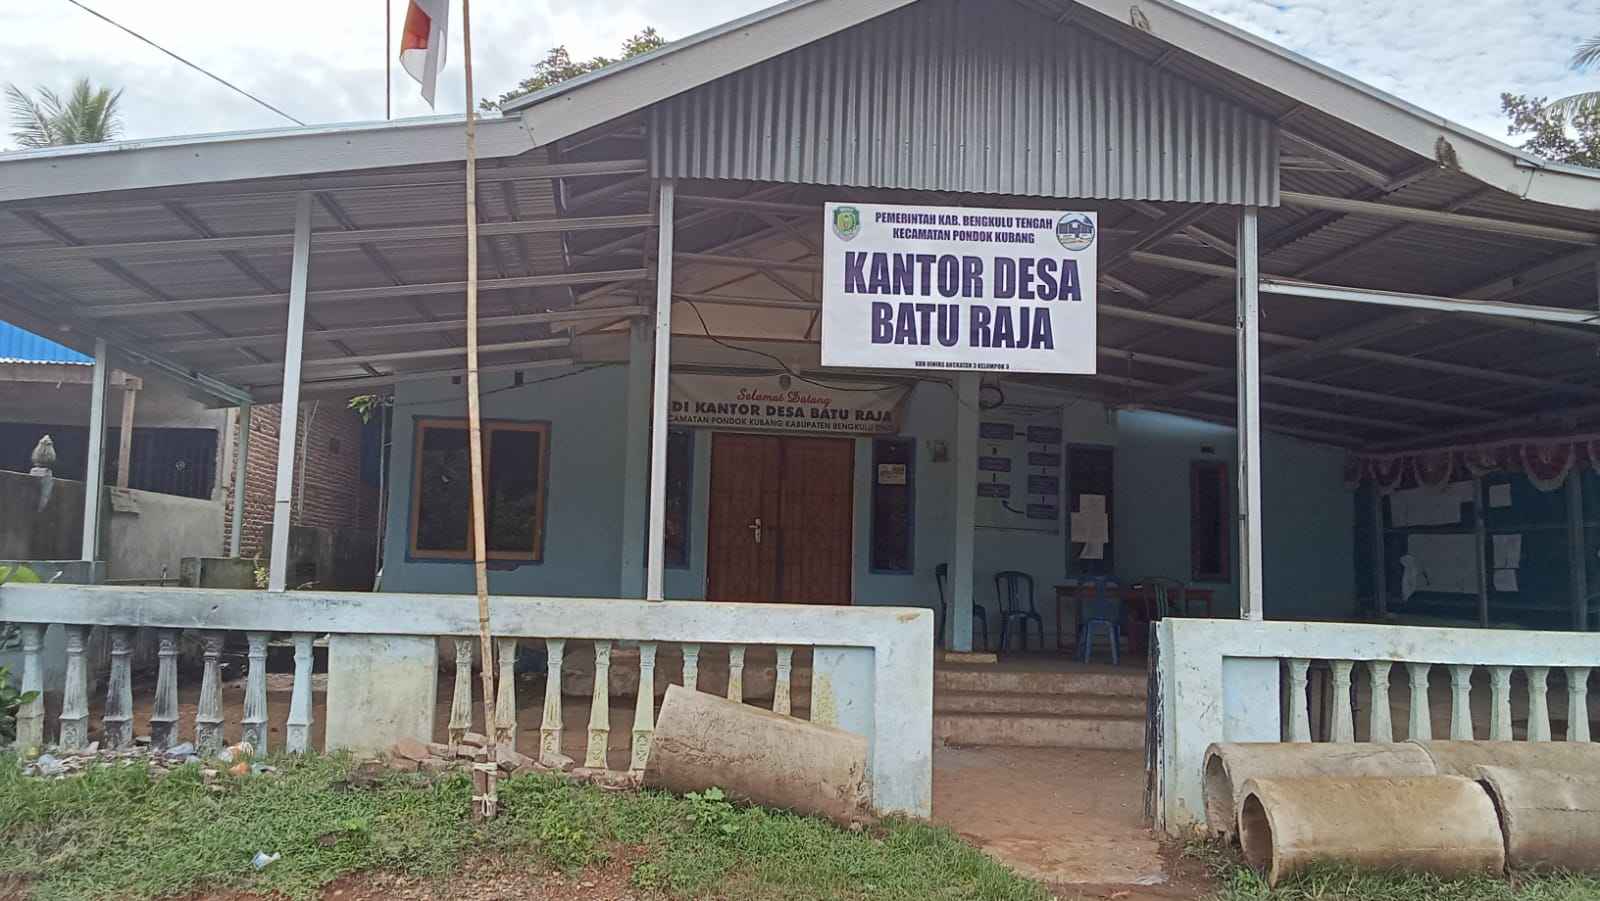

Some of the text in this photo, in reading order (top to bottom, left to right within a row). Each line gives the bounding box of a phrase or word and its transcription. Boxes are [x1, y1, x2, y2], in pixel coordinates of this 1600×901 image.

[875, 212, 1053, 230] PEMERINTAH KAB. BENGKULU TENGAH
[893, 227, 1035, 244] KECAMATAN PONDOK KUBANG
[845, 250, 1081, 301] KANTOR DESA
[871, 301, 1055, 350] BATU RAJA
[736, 388, 784, 402] Selamat
[671, 400, 892, 422] DI KANTOR DESA BATU RAJA
[711, 416, 748, 425] PONDOK
[785, 420, 831, 430] KABUPATEN
